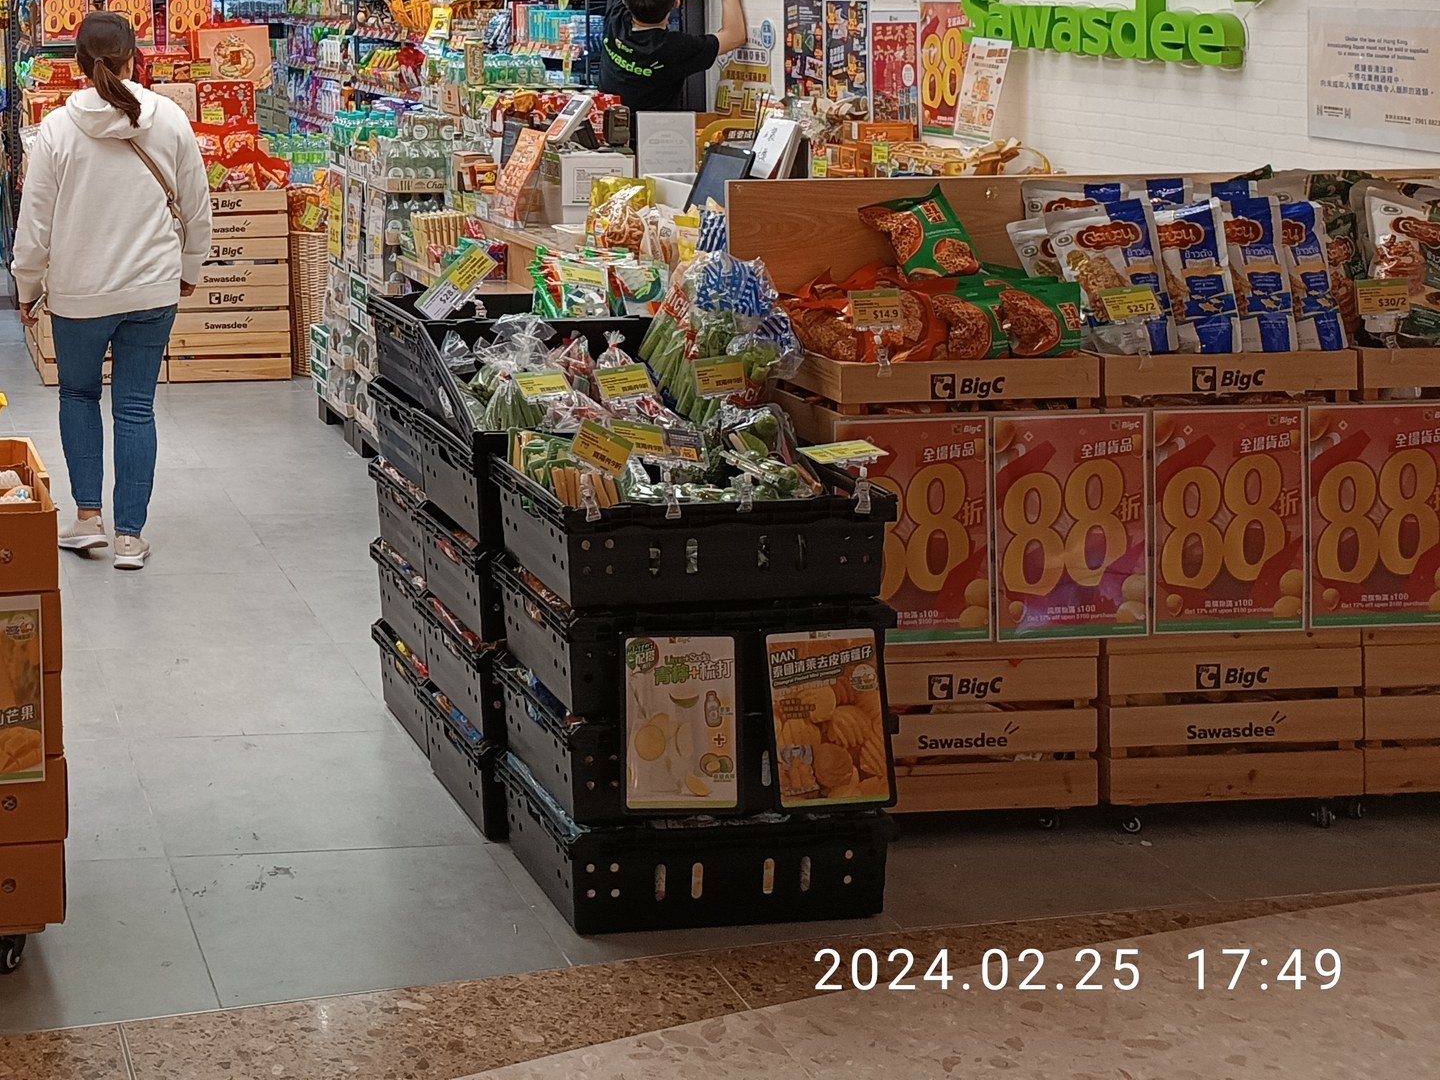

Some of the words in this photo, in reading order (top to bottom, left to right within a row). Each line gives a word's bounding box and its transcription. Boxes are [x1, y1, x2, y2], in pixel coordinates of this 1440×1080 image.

[922, 28, 963, 108] 88
[221, 198, 242, 209] BigC
[222, 246, 243, 257] BigC
[203, 273, 246, 283] Sawasdee
[223, 293, 244, 304] BigC
[1127, 301, 1156, 314] $25/2
[1378, 297, 1407, 309] $30/2
[873, 309, 899, 319] $14.9
[205, 320, 247, 330] Sawasdee
[959, 376, 1005, 398] BigC
[1220, 369, 1265, 390] BigC
[963, 422, 982, 434] BigC
[1121, 419, 1141, 431] BigC
[1279, 415, 1298, 426] BigC
[922, 438, 976, 464] 全場貨品
[1080, 435, 1134, 460] 全場貨品
[1240, 431, 1291, 455] 全場貨品
[962, 495, 984, 527] 折
[1120, 492, 1142, 522] 折
[1278, 488, 1299, 517] 折
[1160, 452, 1286, 591] 88
[1316, 447, 1440, 586] 88
[1002, 457, 1129, 597] 88
[771, 649, 796, 664] NAN
[1224, 665, 1269, 687] BigC
[957, 676, 1003, 698] BigC
[1186, 721, 1276, 741] Sawasdee
[918, 732, 1008, 751] Sawasdee
